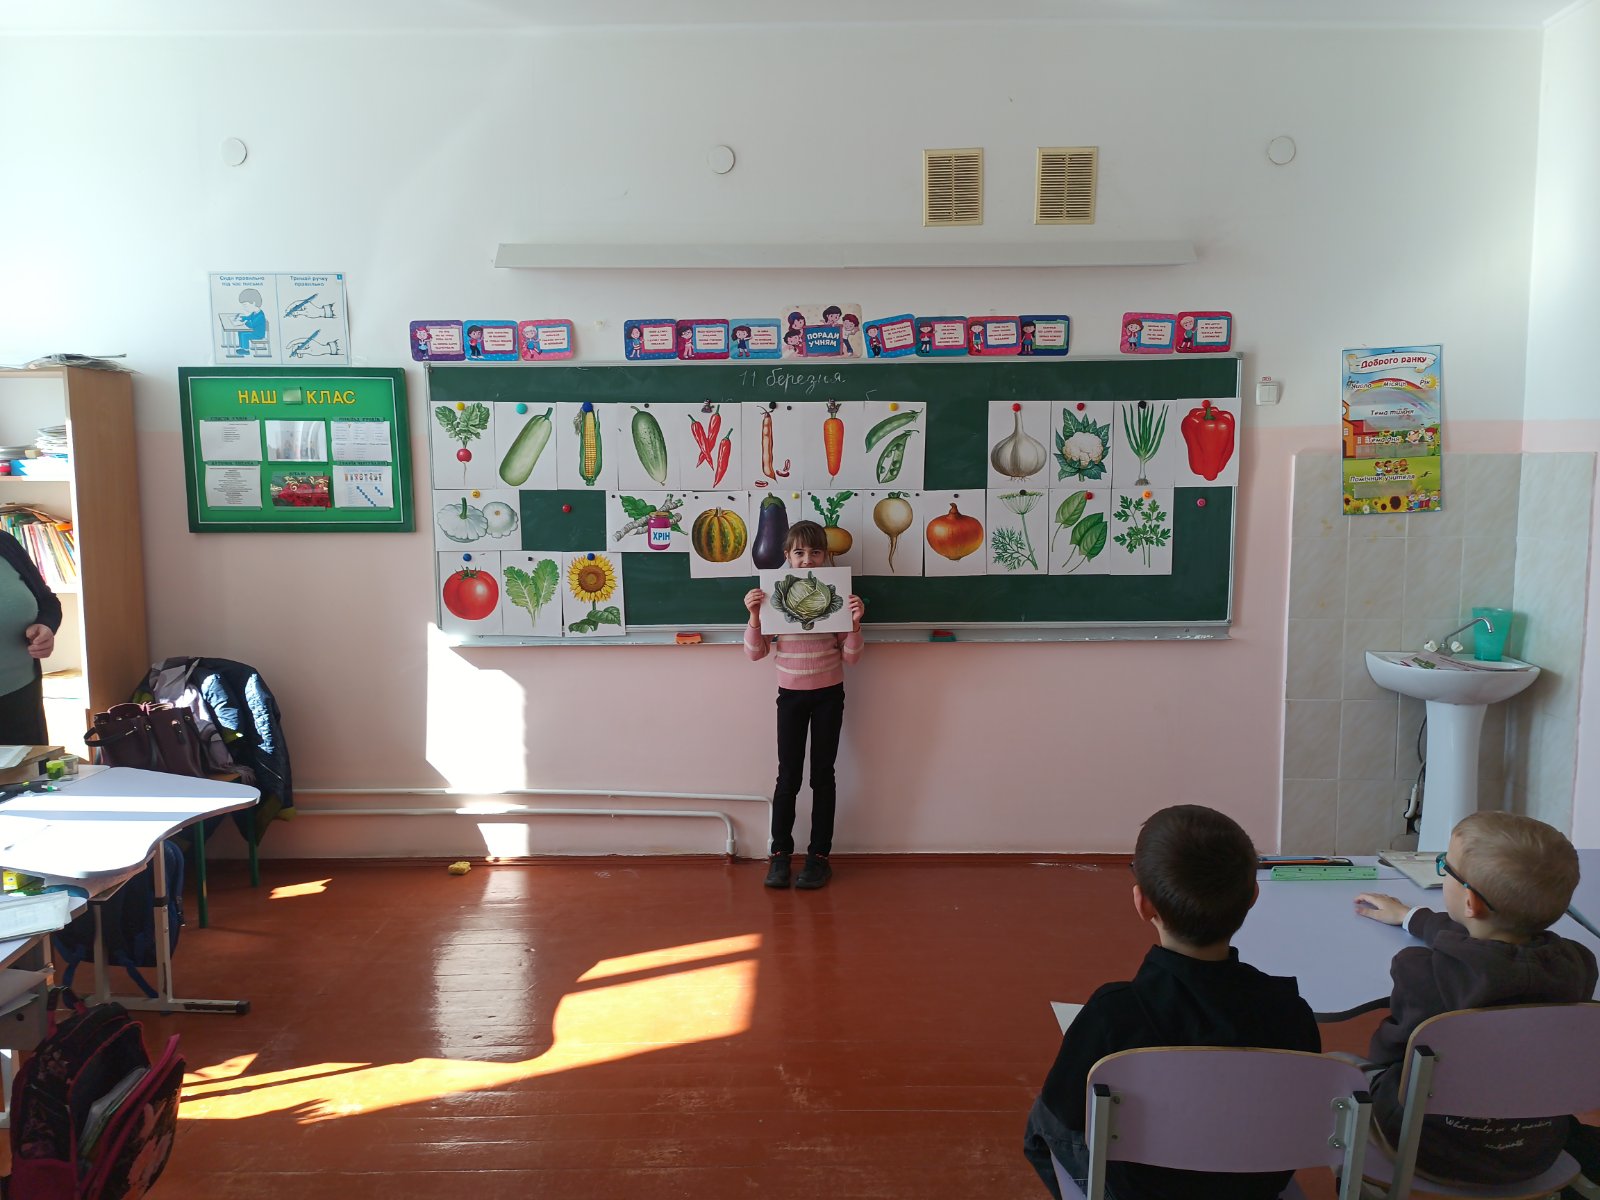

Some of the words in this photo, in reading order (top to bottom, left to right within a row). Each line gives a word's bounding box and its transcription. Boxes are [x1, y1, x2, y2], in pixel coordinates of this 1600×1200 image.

[807, 332, 839, 340] ПОРАДИ
[1361, 357, 1399, 369] Доброго
[1401, 356, 1427, 364] ранку
[739, 369, 756, 386] 11
[766, 367, 847, 394] березня
[238, 390, 278, 404] НАШ
[306, 390, 356, 404] КЛАС
[653, 532, 670, 541] ХРІН
